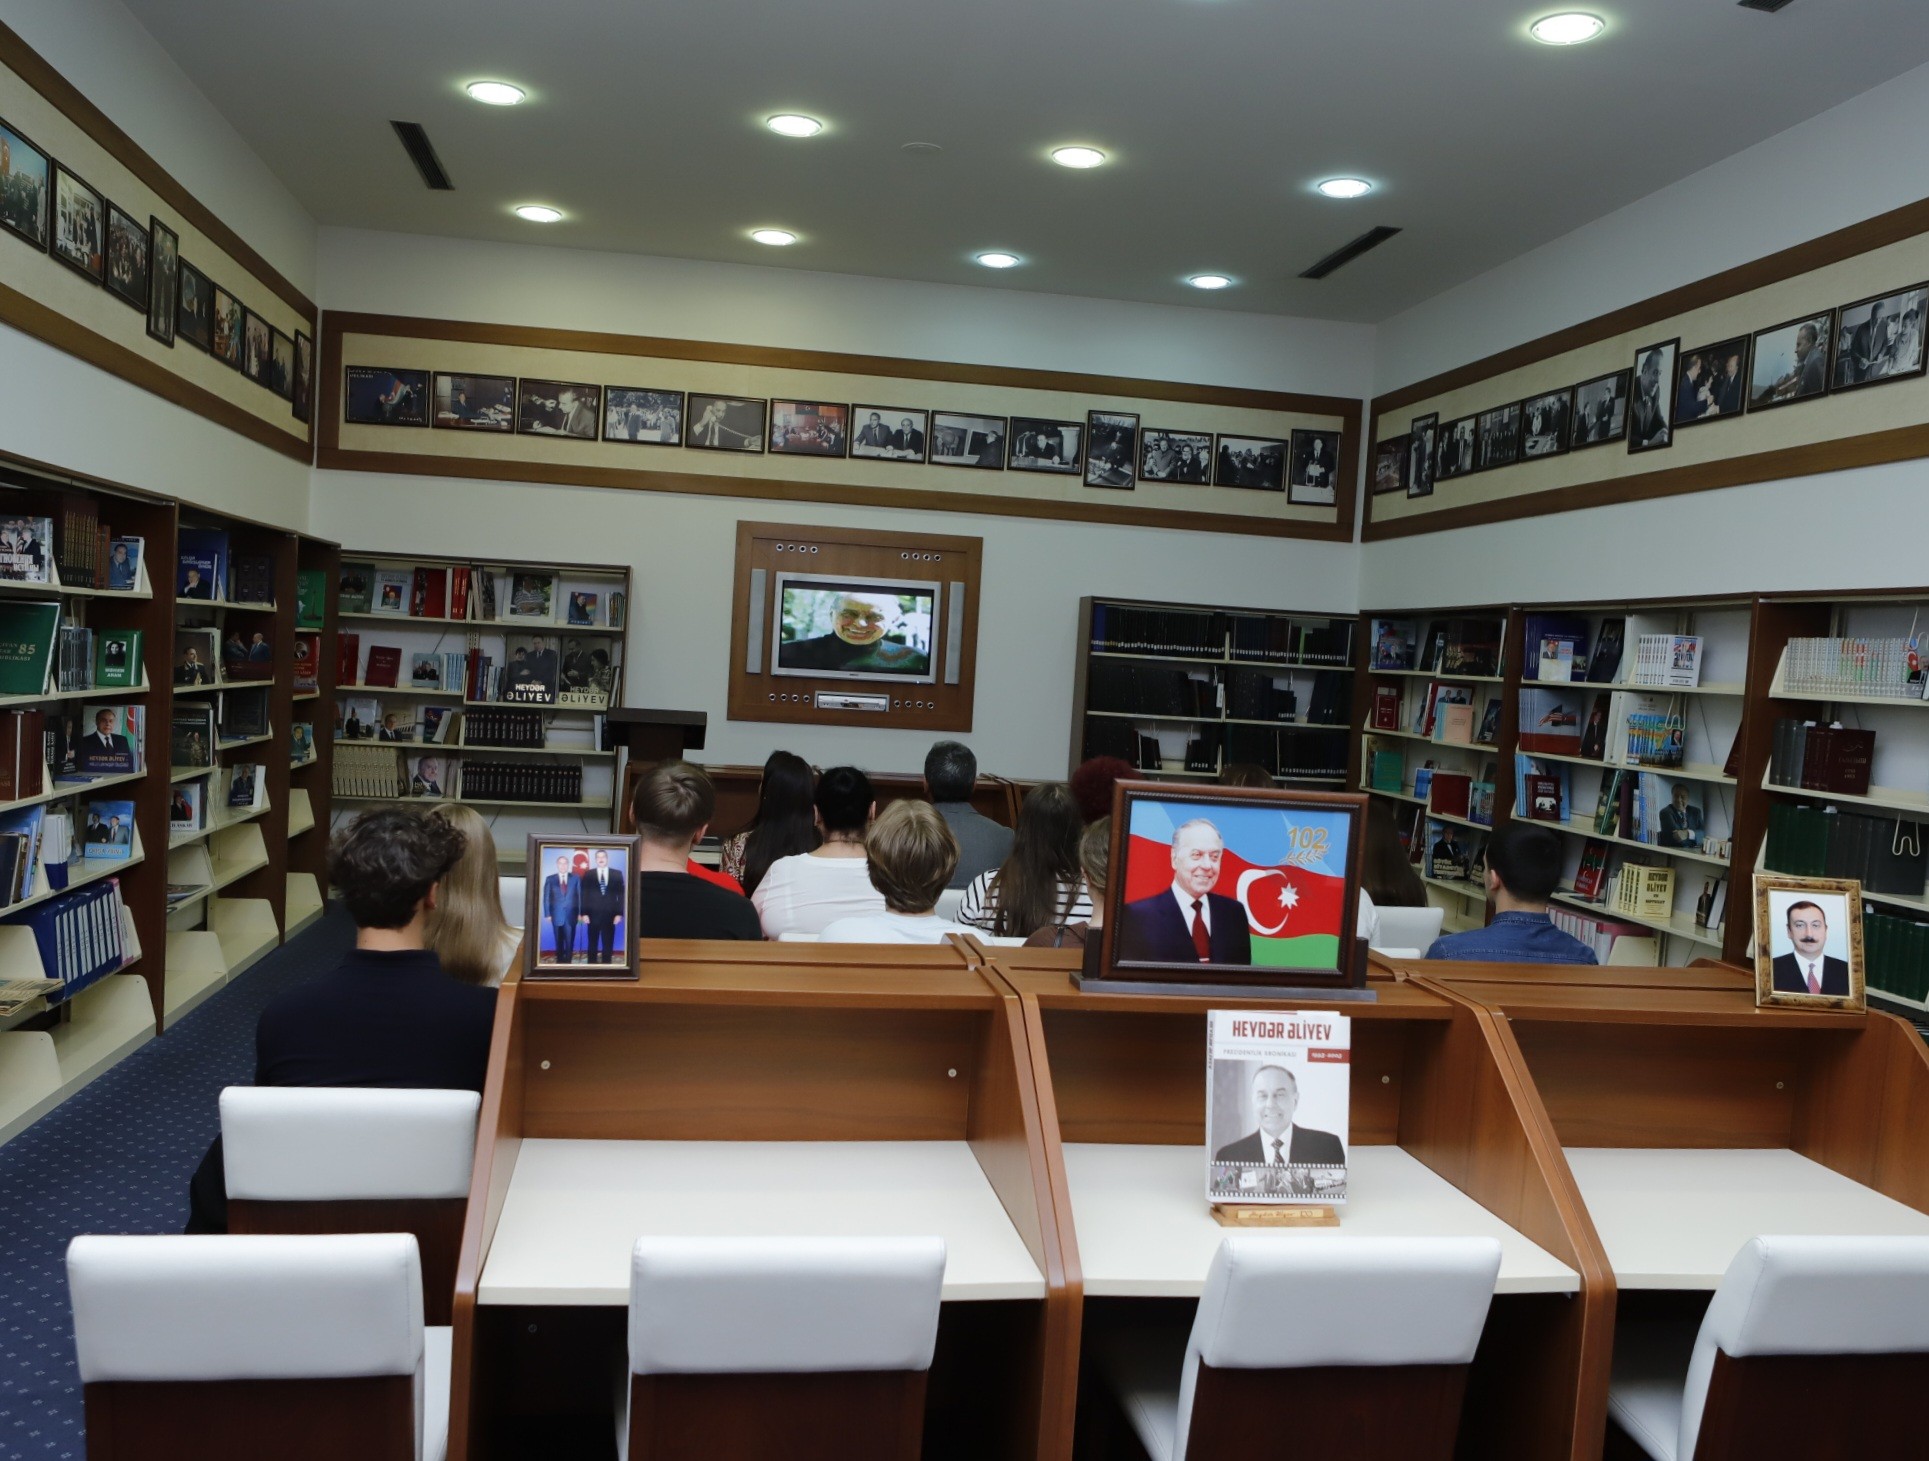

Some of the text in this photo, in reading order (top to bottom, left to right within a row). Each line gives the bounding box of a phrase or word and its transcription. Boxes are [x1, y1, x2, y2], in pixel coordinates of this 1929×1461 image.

[18, 643, 36, 655] 85
[515, 684, 546, 692] HEYDƏR
[1287, 826, 1328, 850] 102
[1233, 1019, 1332, 1041] HEYDƏR ƏLİYEV
